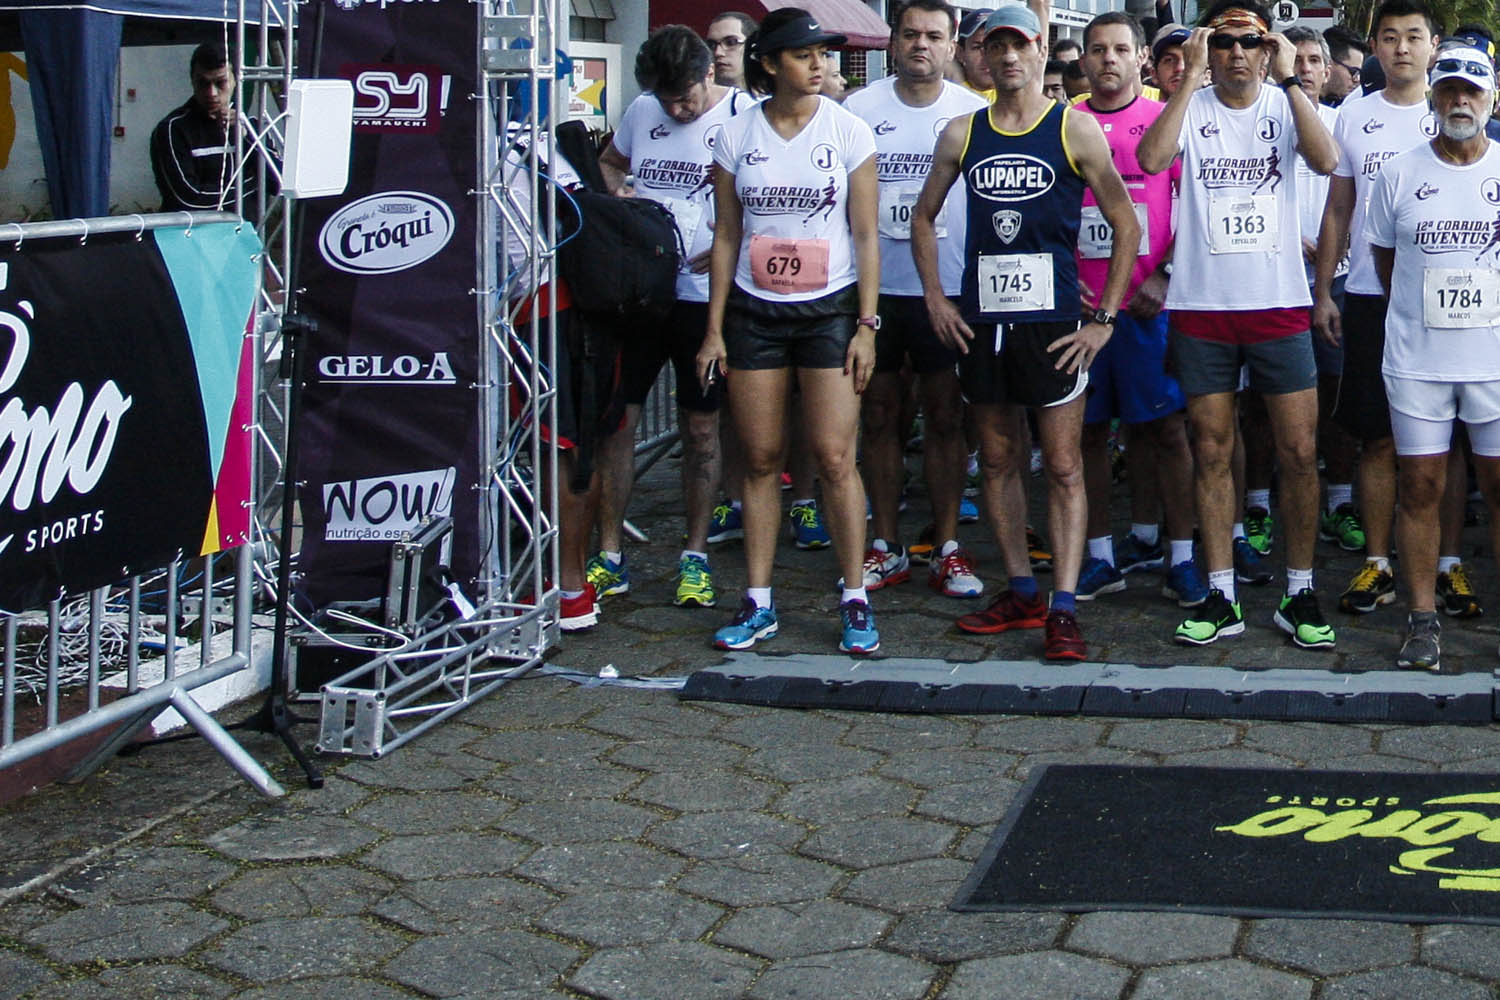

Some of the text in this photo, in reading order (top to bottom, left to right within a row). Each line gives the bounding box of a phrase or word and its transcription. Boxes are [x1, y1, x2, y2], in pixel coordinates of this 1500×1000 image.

[1217, 158, 1265, 169] CORRIDA
[637, 167, 701, 186] JUVENTUS
[975, 166, 1047, 190] LUPAPEL
[1196, 168, 1265, 181] JUVENTUS
[762, 186, 820, 197] CORRIDA
[340, 210, 433, 259] Cróqui
[1222, 215, 1265, 235] 1363
[1436, 220, 1490, 232] CORRIDA
[1413, 232, 1490, 245] JUVENTUS
[766, 256, 801, 276] 679
[990, 273, 1032, 294] 1745
[1437, 289, 1482, 308] 1784
[319, 352, 455, 380] GELO-A
[26, 510, 104, 552] SPORTS
[327, 527, 380, 540] nutrição
[1265, 795, 1400, 807] SPORTS
